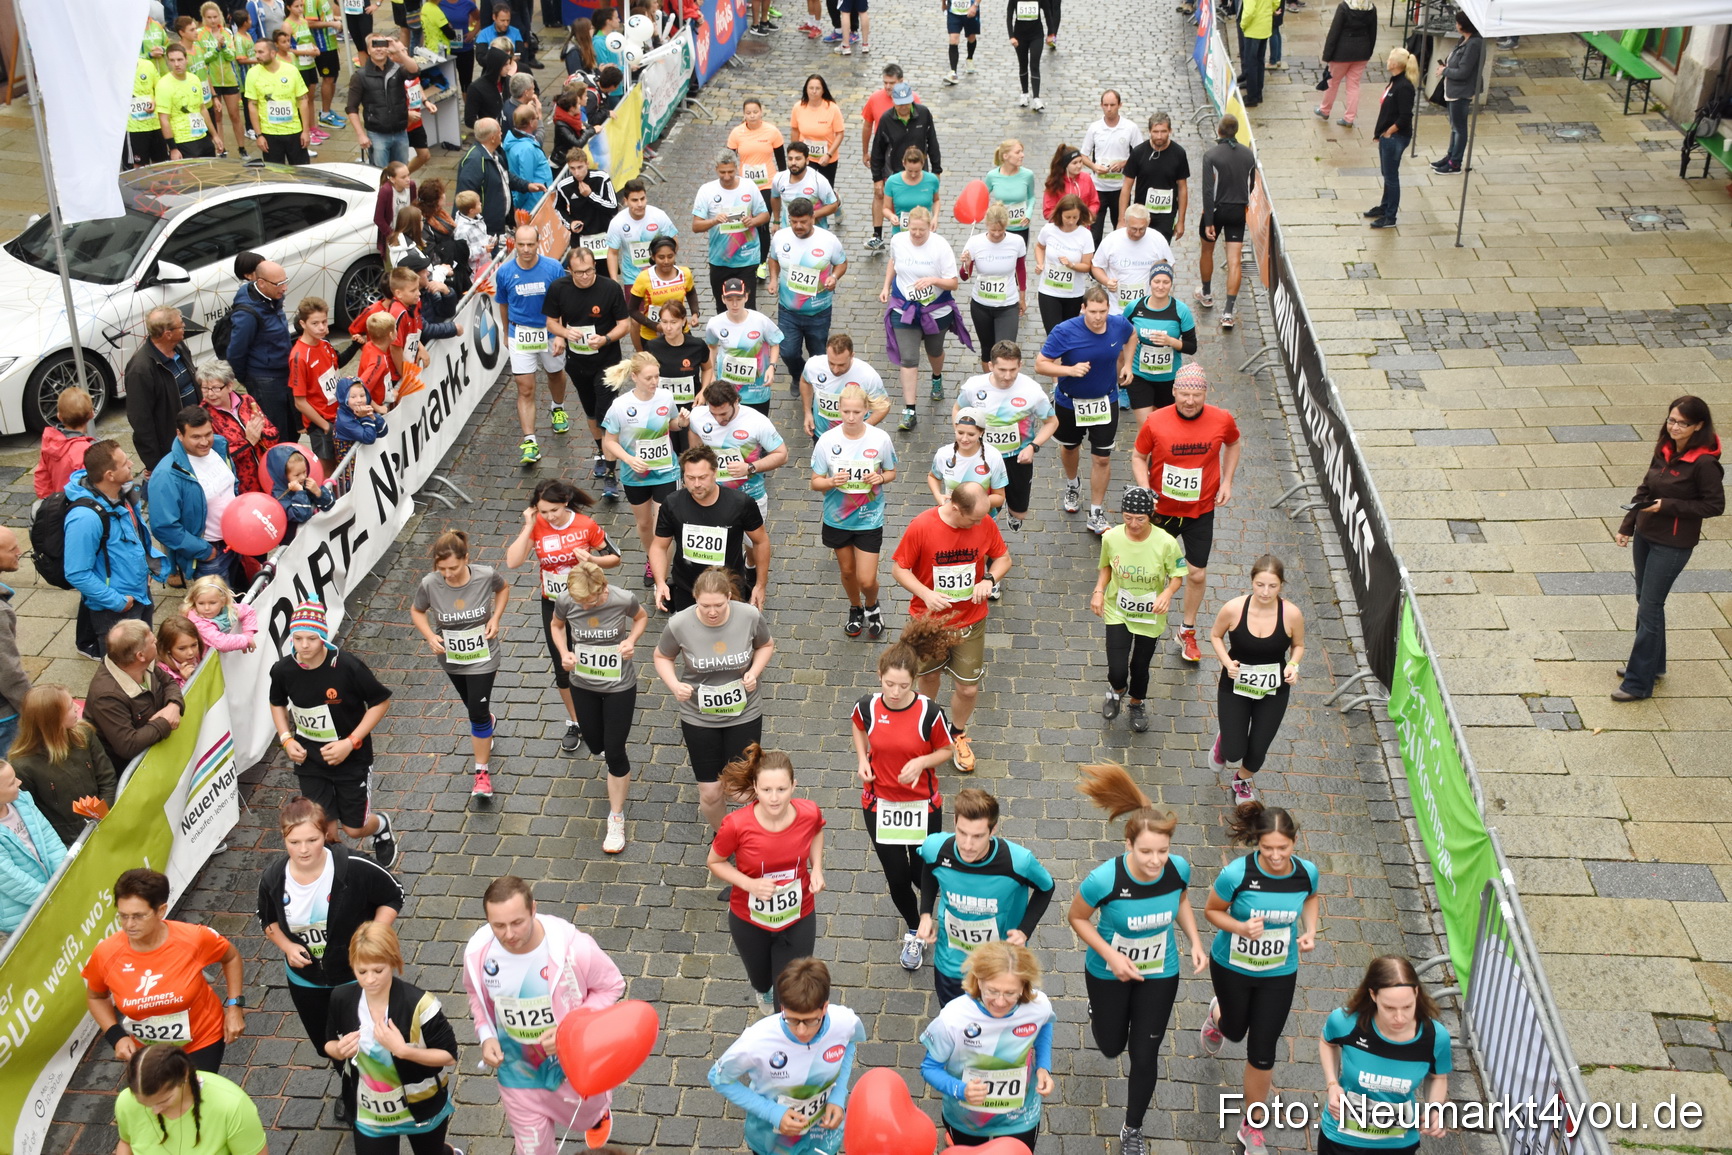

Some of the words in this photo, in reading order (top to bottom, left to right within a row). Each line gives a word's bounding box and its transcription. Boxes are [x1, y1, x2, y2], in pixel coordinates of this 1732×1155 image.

[1020, 6, 1036, 14] 5133
[270, 106, 291, 116] 2905
[744, 170, 765, 180] 5041
[1008, 205, 1025, 218] 025
[634, 248, 652, 258] 521
[790, 271, 816, 286] 5247
[1048, 269, 1072, 282] 5279
[908, 285, 934, 302] 5092
[980, 280, 1005, 292] 5012
[1120, 288, 1145, 300] 5278
[204, 308, 223, 322] THE
[518, 331, 545, 343] 5079
[1143, 352, 1170, 364] 5159
[725, 362, 754, 376] 5167
[662, 384, 691, 394] 5114
[820, 398, 839, 411] 520
[1078, 401, 1107, 414] 5178
[986, 432, 1016, 444] 5326
[640, 443, 669, 460] 5305
[1166, 472, 1197, 489] 5215
[1172, 489, 1189, 497] Günter
[687, 534, 722, 551] 5280
[693, 552, 713, 560] Markus
[547, 580, 568, 594] 502
[938, 573, 972, 588] 5313
[1120, 597, 1154, 613] 5260
[438, 607, 486, 622] LEHMEIER
[449, 635, 484, 652] 5054
[455, 652, 480, 660] Christine
[580, 652, 618, 668] 5106
[692, 651, 750, 669] LEHMEIER
[1240, 673, 1276, 688] 5270
[704, 688, 742, 707] 5063
[294, 712, 326, 729] 5027
[190, 814, 214, 844] einkaufen
[215, 798, 229, 816] leben
[882, 810, 922, 827] 5001
[755, 890, 797, 912] 5158
[946, 890, 998, 910] HUBER
[1128, 910, 1172, 929] HUBER
[1250, 908, 1297, 922] HUBER
[949, 923, 992, 943] 5157
[1117, 944, 1162, 961] 5017
[1237, 937, 1284, 956] 5080
[1248, 958, 1269, 966] Sonja
[122, 992, 174, 1008] funrunners
[137, 996, 184, 1011] neumarkt
[504, 1007, 554, 1026] 5125
[132, 1023, 184, 1040] 5322
[983, 1079, 1021, 1096] 070
[1358, 1070, 1412, 1090] HUBER
[361, 1093, 408, 1113] 5101
[796, 1092, 827, 1117] 139
